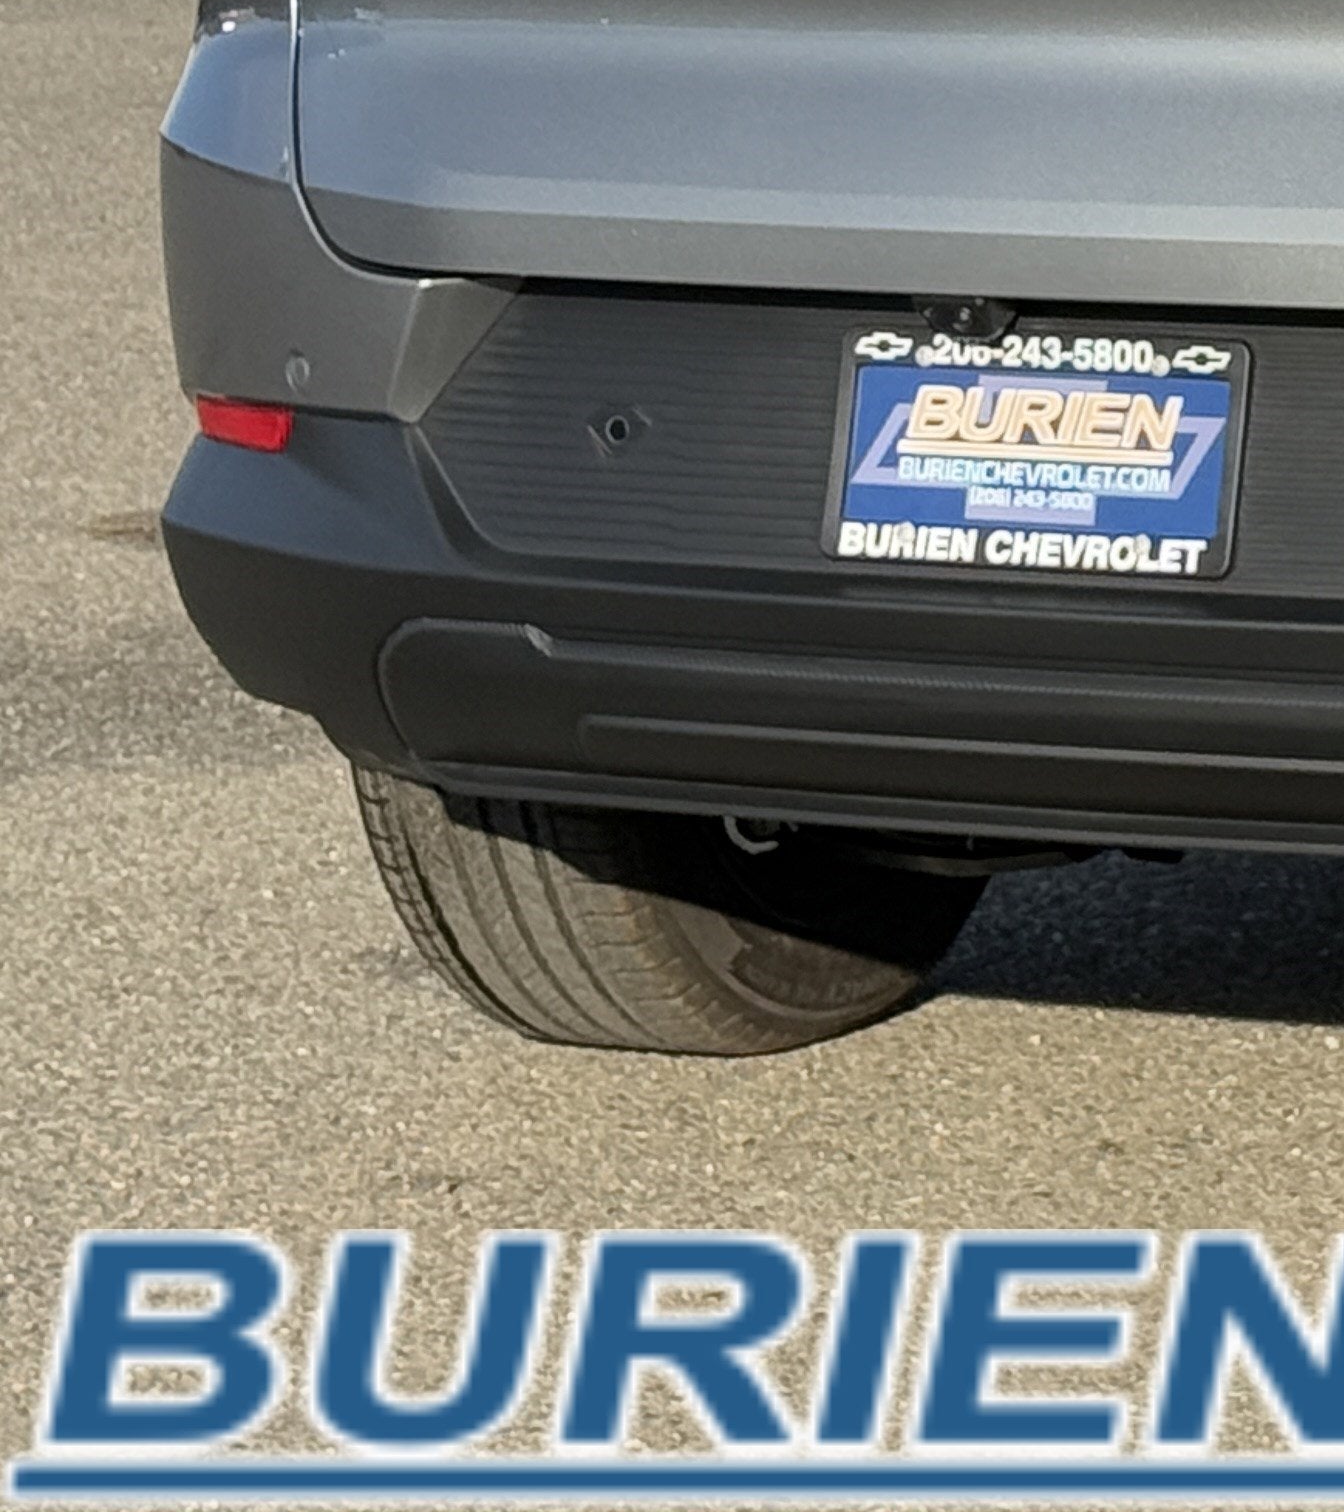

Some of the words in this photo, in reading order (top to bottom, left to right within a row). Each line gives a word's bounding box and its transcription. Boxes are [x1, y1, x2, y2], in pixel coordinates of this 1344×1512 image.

[906, 384, 1185, 452] BURIEN
[837, 521, 978, 562] BURIEN
[984, 531, 1208, 575] CHEVROLET
